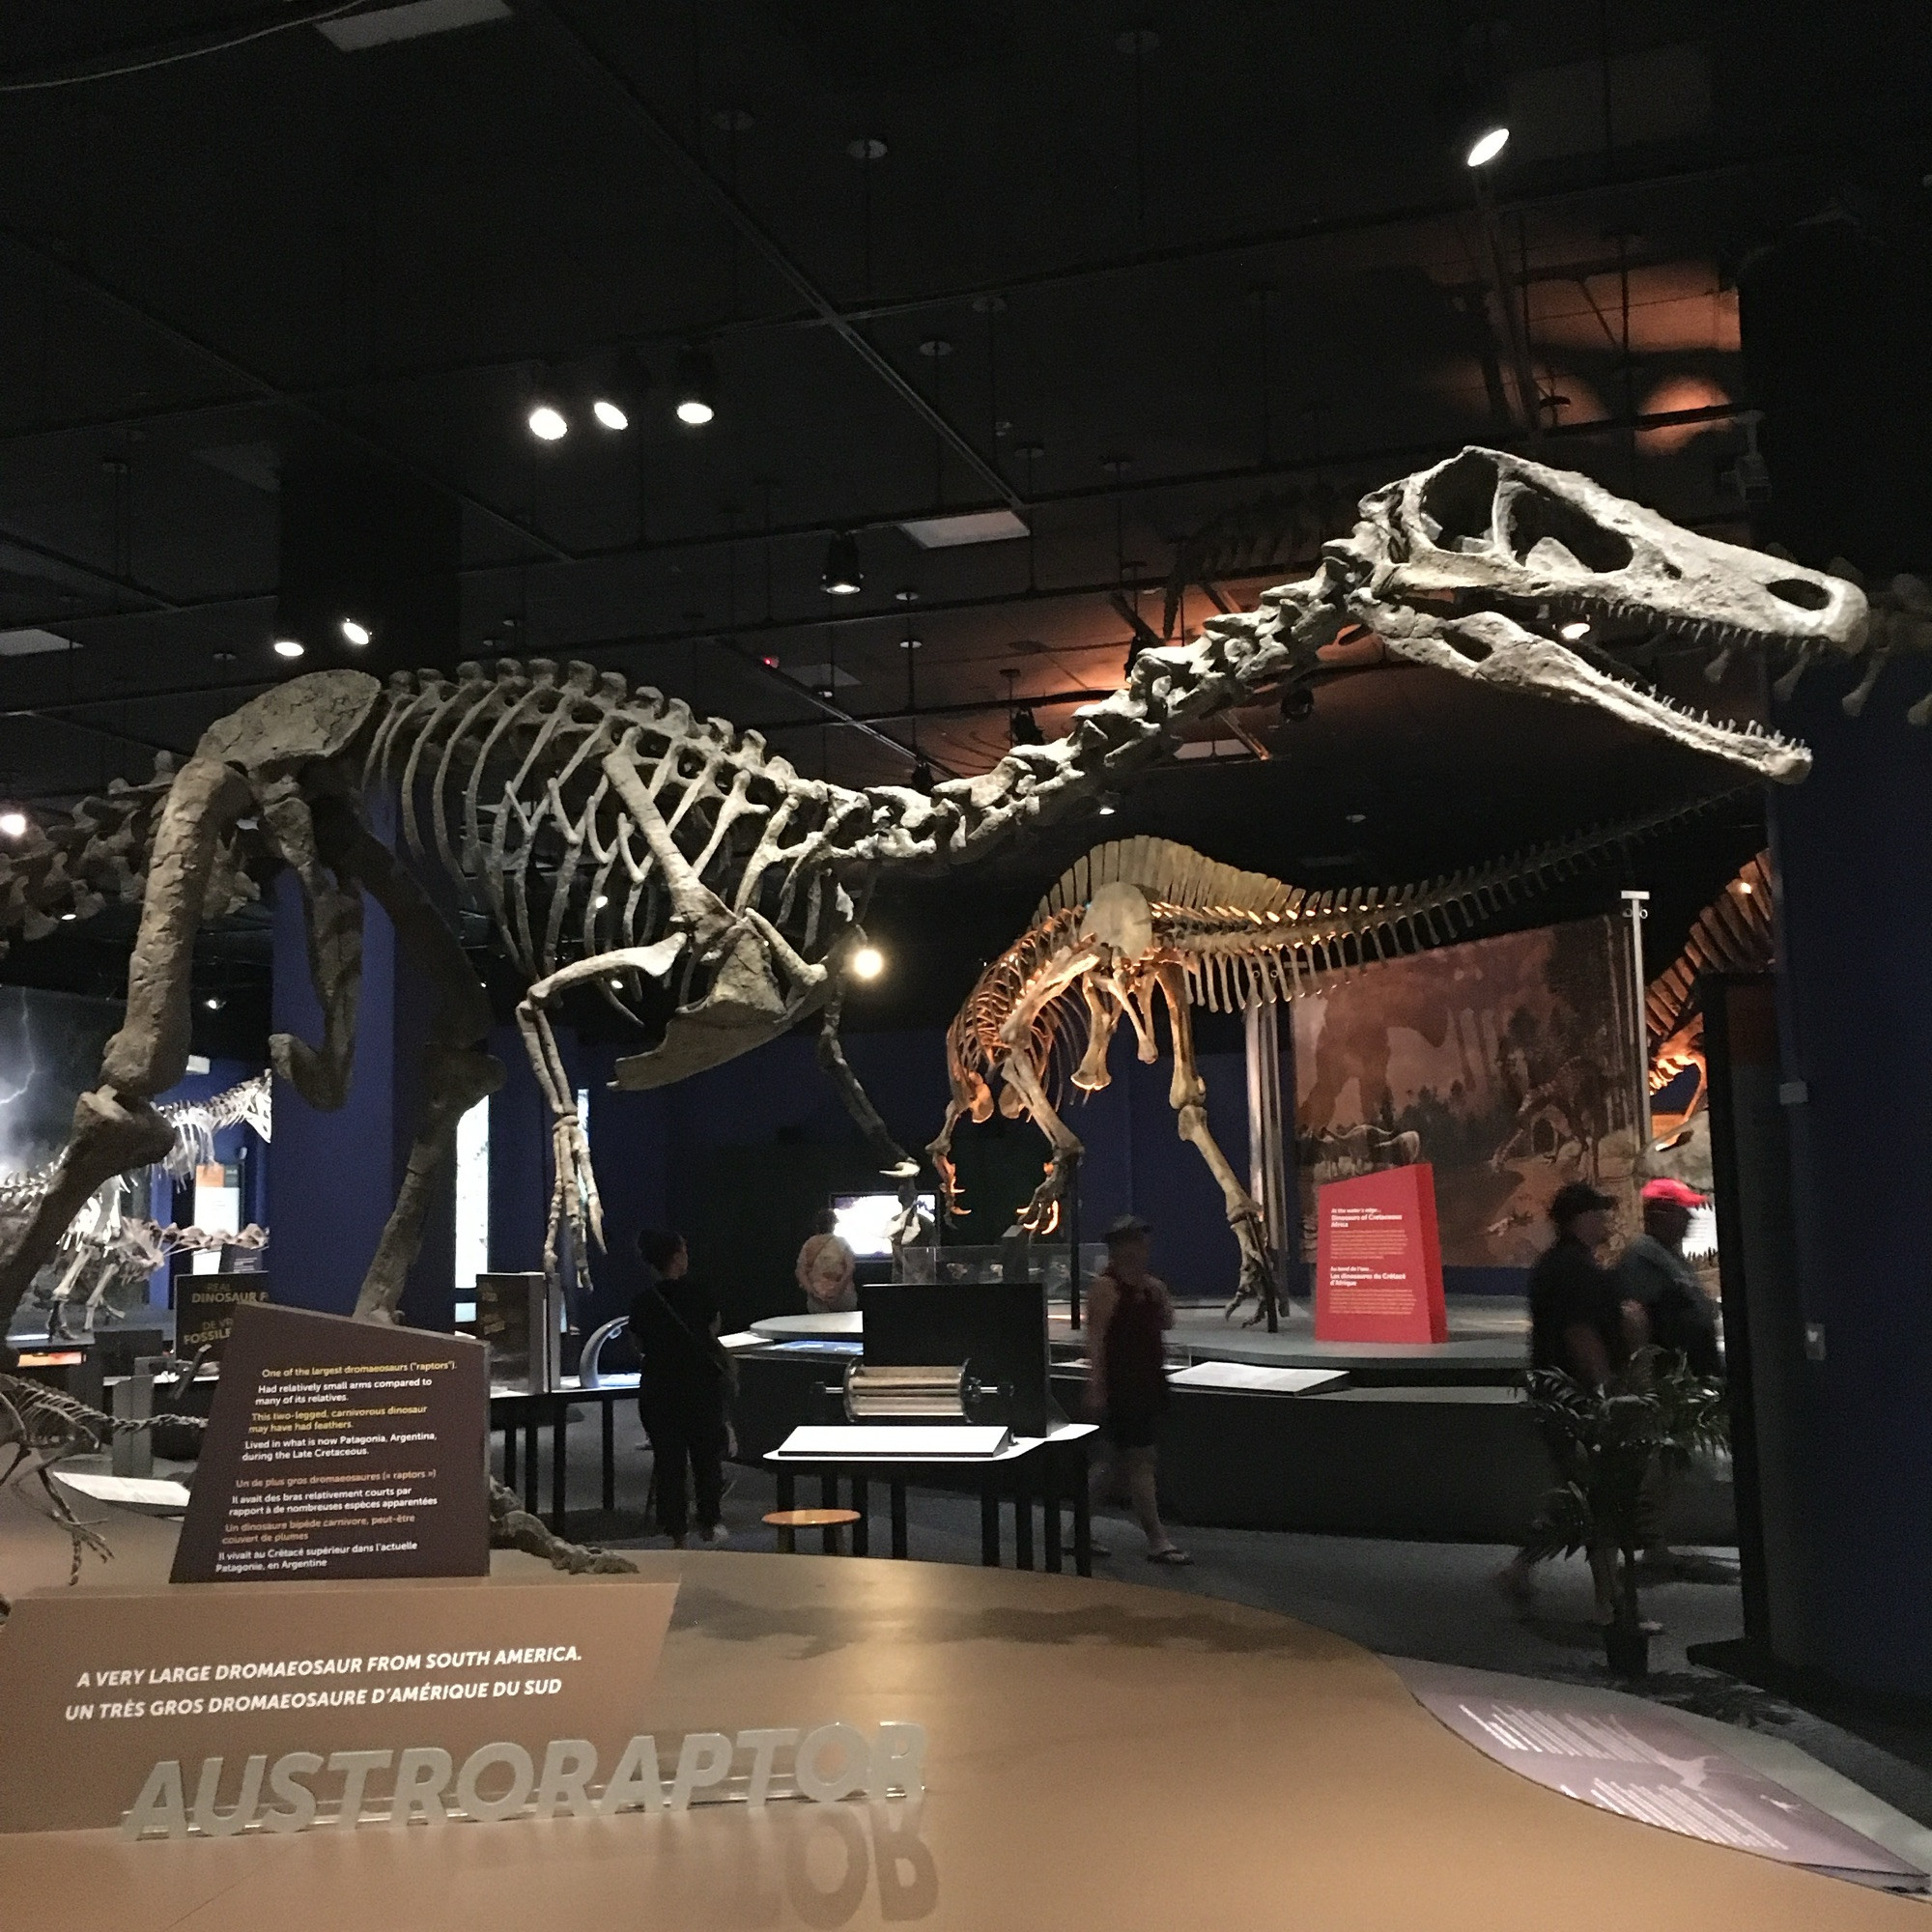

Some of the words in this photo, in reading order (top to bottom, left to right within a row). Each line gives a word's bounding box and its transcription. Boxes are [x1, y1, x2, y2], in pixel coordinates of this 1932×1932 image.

[192, 1291, 256, 1303] DINOSAUR
[282, 1368, 293, 1376] of
[311, 1366, 342, 1376] largest
[343, 1364, 408, 1373] dromaeosaurs
[278, 1383, 321, 1392] relatively
[323, 1381, 347, 1390] small
[373, 1378, 420, 1388] compared
[330, 1408, 385, 1417] carnivorous
[295, 1422, 311, 1430] had
[244, 1440, 270, 1448] Lived
[242, 1452, 272, 1461] during
[314, 1448, 369, 1456] Cretaceous.
[265, 1478, 284, 1487] plus
[286, 1477, 307, 1486] gros
[309, 1473, 381, 1483] dromaeosaures
[392, 1471, 425, 1480] raptors
[240, 1495, 262, 1503] avait
[264, 1494, 280, 1502] des
[304, 1489, 362, 1499] relativement
[396, 1488, 412, 1496] par
[228, 1506, 264, 1516] rapport
[286, 1503, 342, 1512] nombreuses
[344, 1500, 380, 1510] espèces
[382, 1497, 437, 1508] apparentées
[241, 1522, 287, 1531] dinosaure
[371, 1514, 414, 1525] peut-être
[226, 1551, 251, 1559] vivait
[267, 1547, 303, 1557] Crétacé
[305, 1546, 350, 1556] supérieur
[214, 1563, 265, 1573] Patagonie,
[280, 1558, 327, 1569] Argentine
[76, 1672, 90, 1688] A
[95, 1668, 145, 1686] VERY
[147, 1665, 211, 1684] LARGE
[214, 1657, 362, 1680] DROMAEOSAUR
[366, 1654, 421, 1672] FROM
[425, 1650, 491, 1669] SOUTH
[492, 1645, 582, 1665] AMERICA.
[64, 1704, 94, 1721] UN
[98, 1698, 146, 1719] TRÈS
[148, 1698, 204, 1716] GROS
[207, 1688, 368, 1713] DROMAEOSAURE
[369, 1681, 489, 1704] D'AMÉRIQUE
[491, 1680, 521, 1697] DU
[522, 1678, 564, 1695] SUD
[120, 1721, 927, 1841] AUSTRORAPTOR
